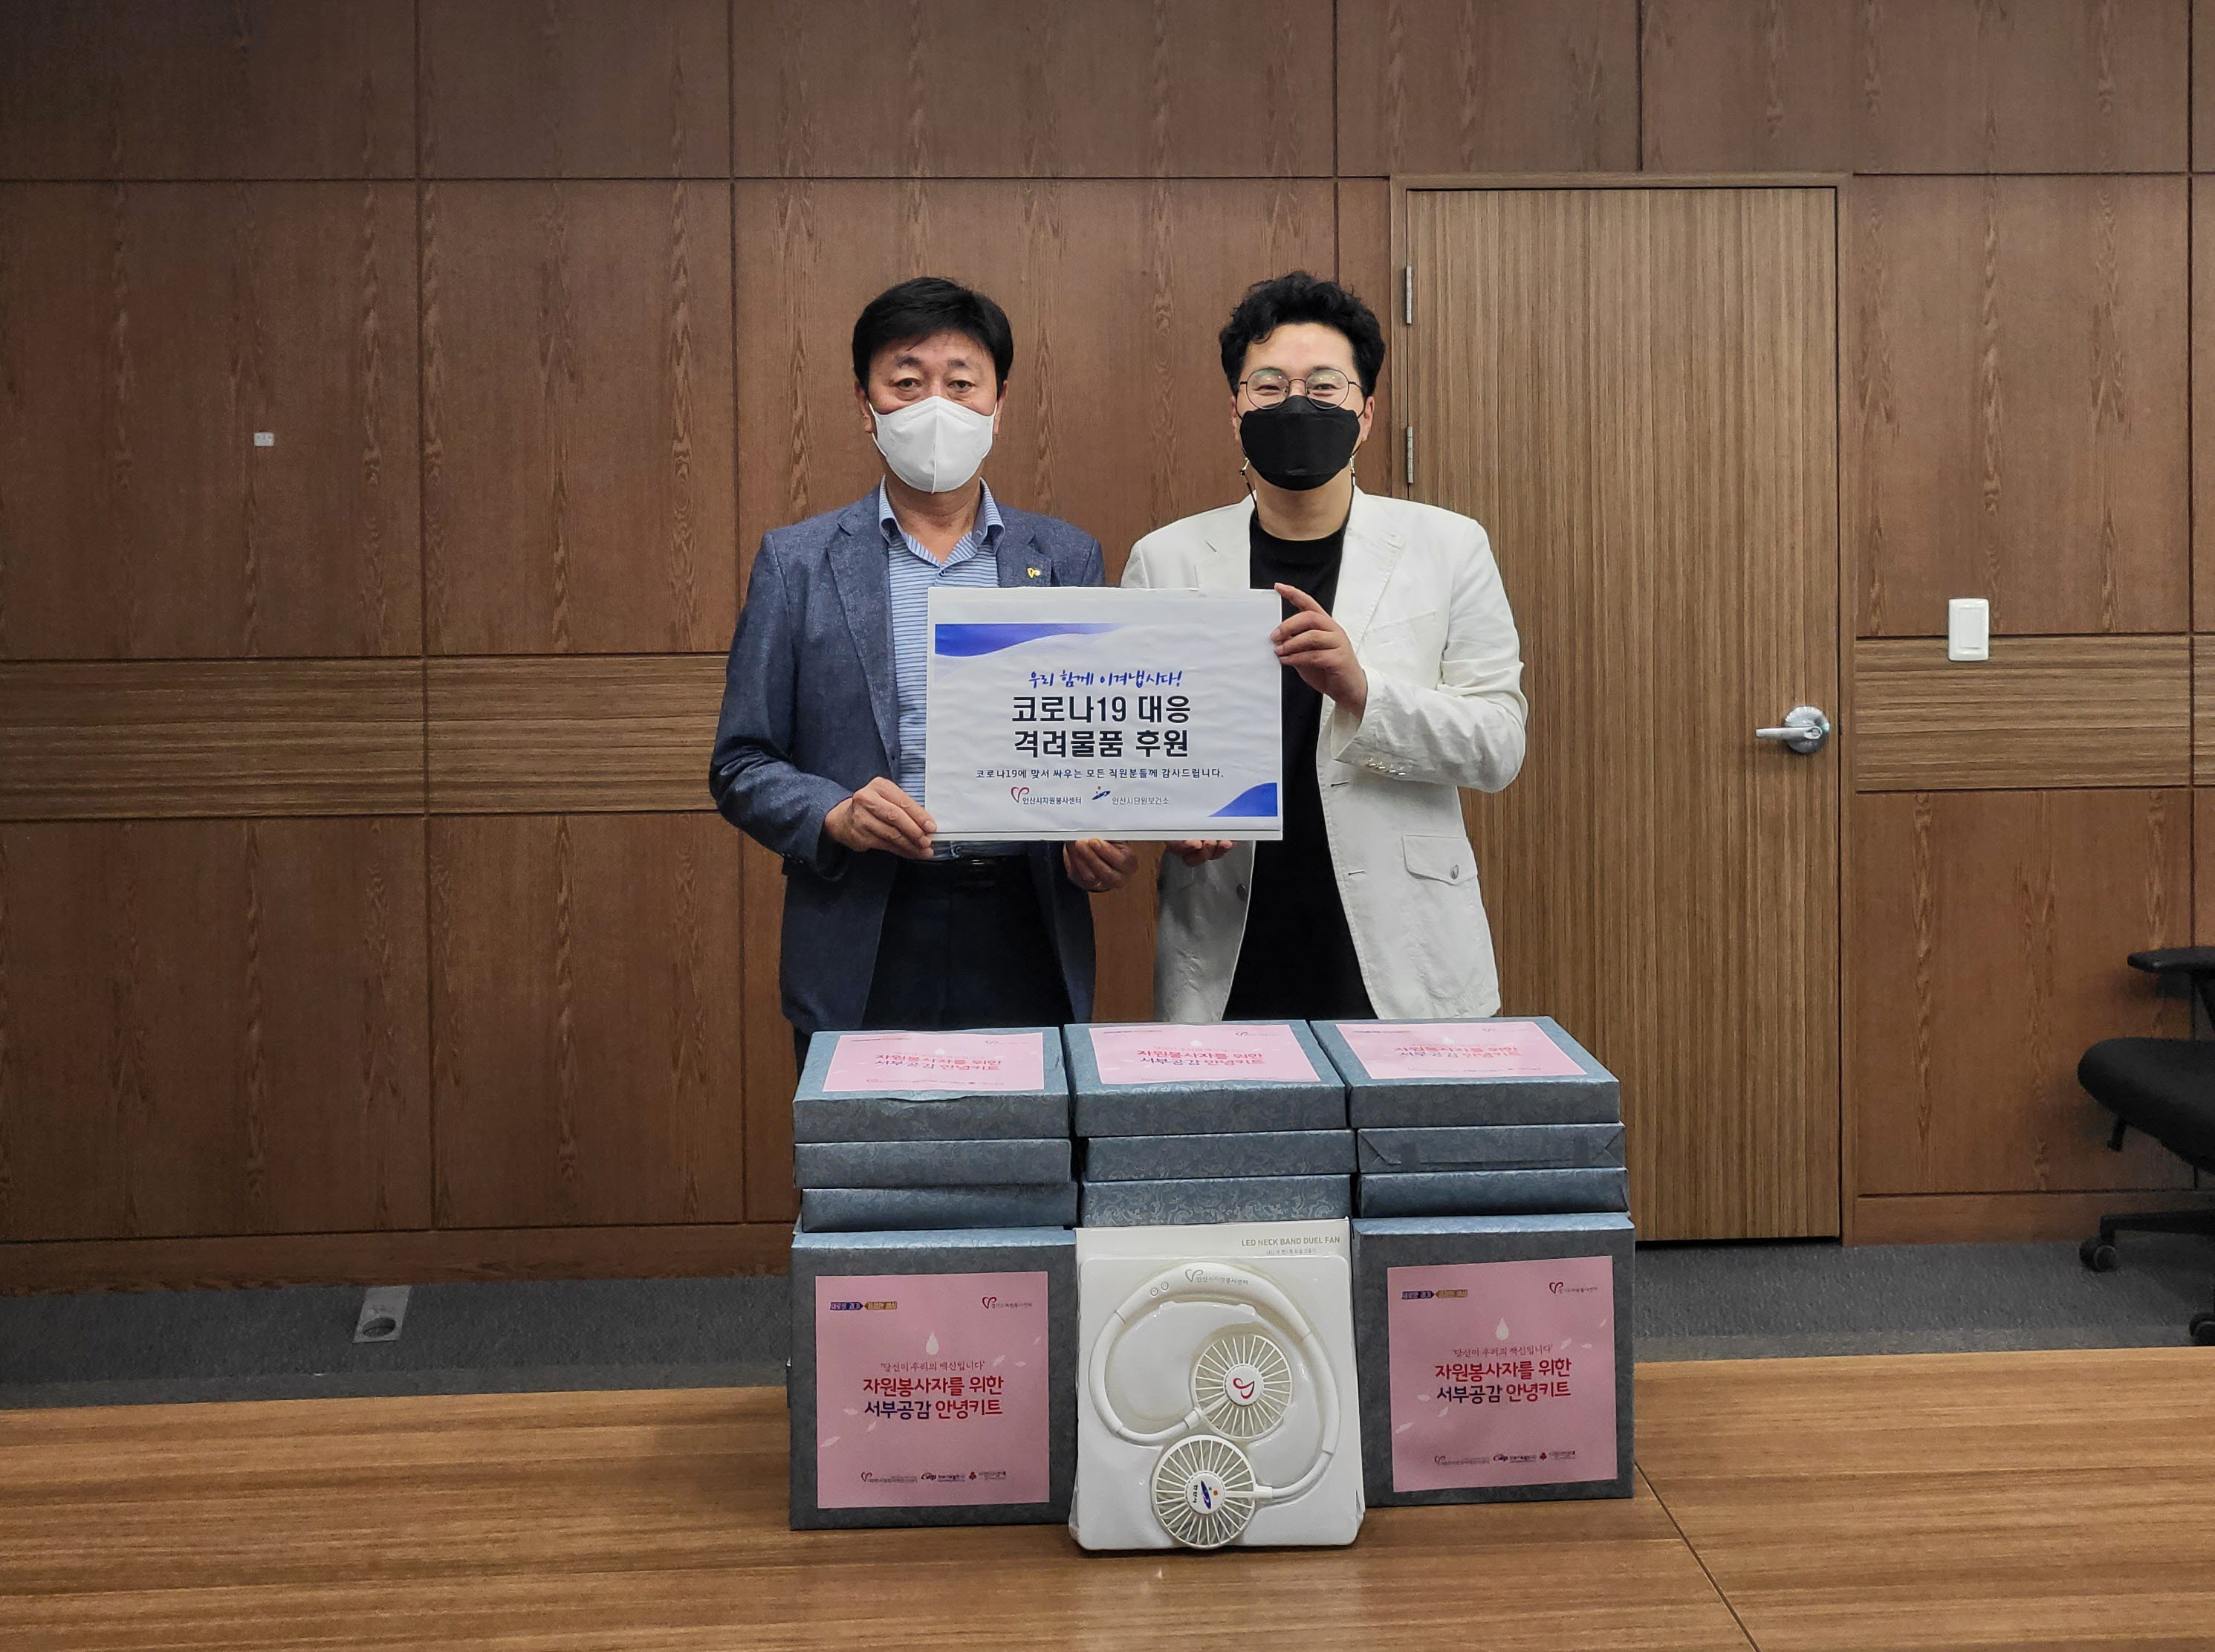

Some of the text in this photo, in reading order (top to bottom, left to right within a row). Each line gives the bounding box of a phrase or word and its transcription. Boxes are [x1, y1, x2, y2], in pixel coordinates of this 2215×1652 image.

[1028, 670, 1183, 688] 우리 함께 이겨냅시다!
[1012, 696, 1190, 723] 코로나19 대응
[1014, 730, 1188, 758] 격려물품 후원
[976, 768, 1224, 779] 코로나19에 맞서 싸우는 모든 직원분들께 감사드립니다.
[1022, 797, 1082, 805] 안산시자원봉사센터
[1257, 1238, 1278, 1246] NECK
[1280, 1237, 1302, 1246] BAND
[1325, 1236, 1340, 1244] FAN
[1435, 1358, 1572, 1382] 자원봉사자를 위한
[863, 1376, 1004, 1397] 자원봉사자를 위한
[1436, 1381, 1572, 1405] 서부공감 안녕키트
[864, 1399, 1003, 1420] 서부공감 안녕키트
